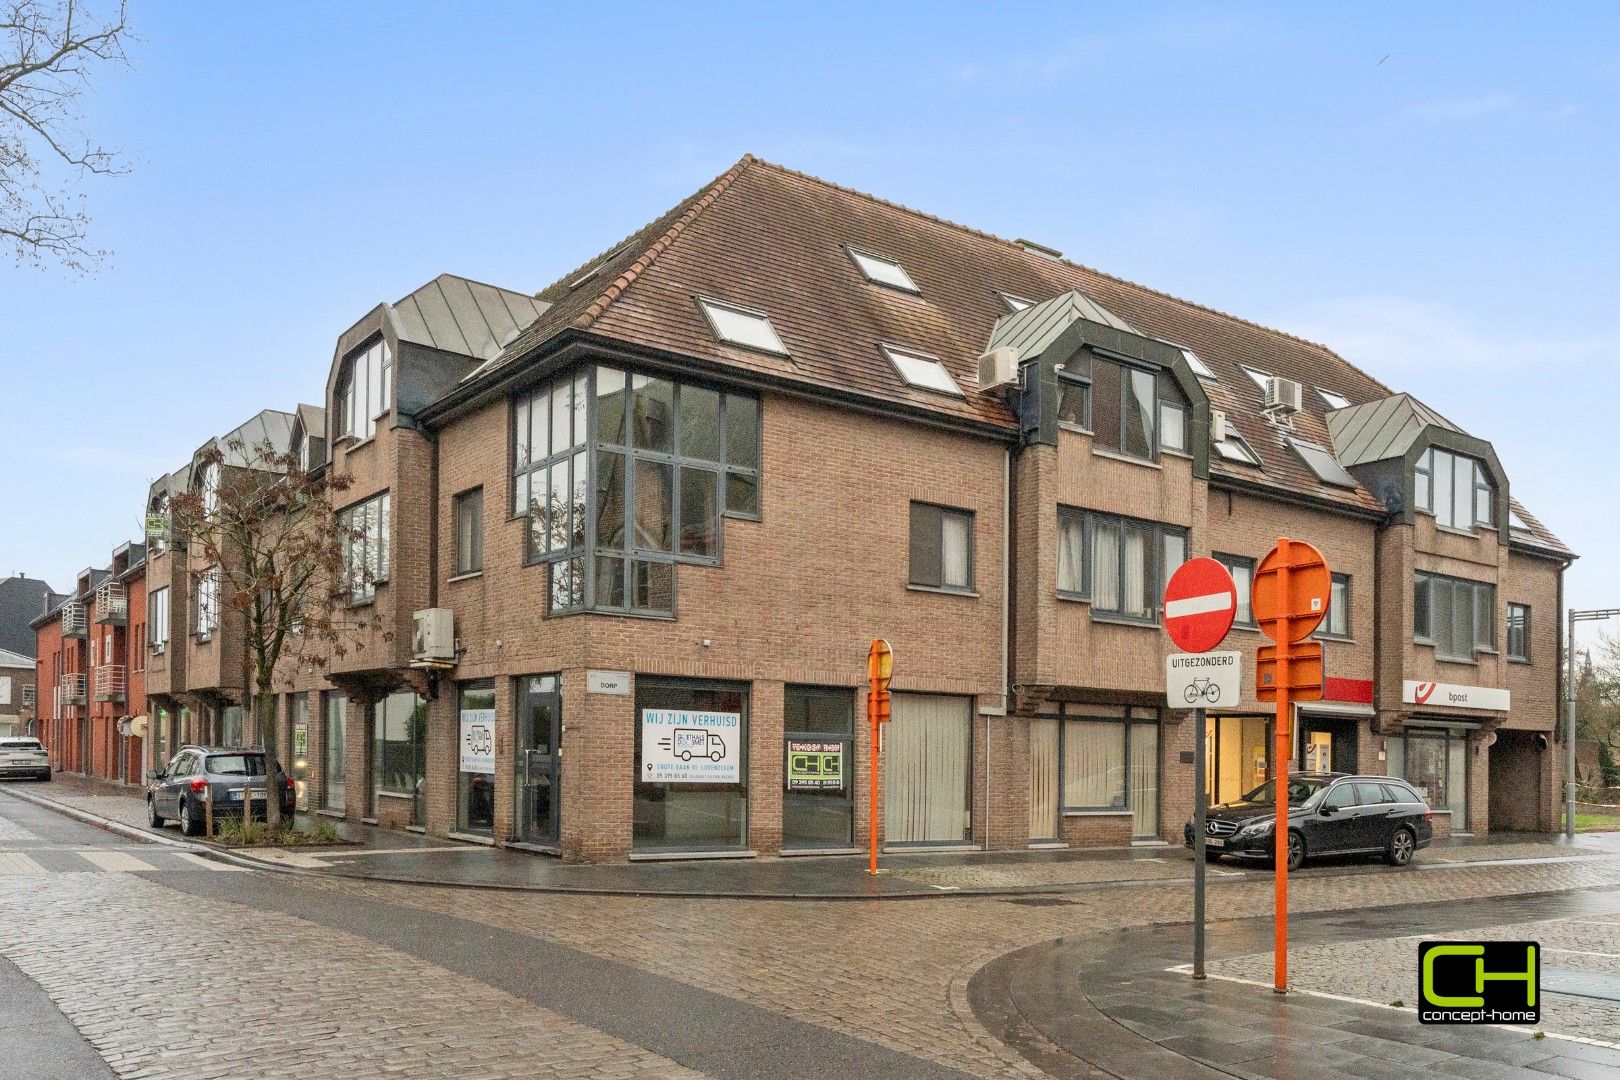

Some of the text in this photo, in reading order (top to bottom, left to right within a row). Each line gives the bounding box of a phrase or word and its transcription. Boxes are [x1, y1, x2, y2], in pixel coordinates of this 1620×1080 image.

[1172, 656, 1234, 668] UITGEZONDERD
[1449, 691, 1468, 703] bpost
[646, 713, 736, 726] WIJ ZIJN VERHUISD
